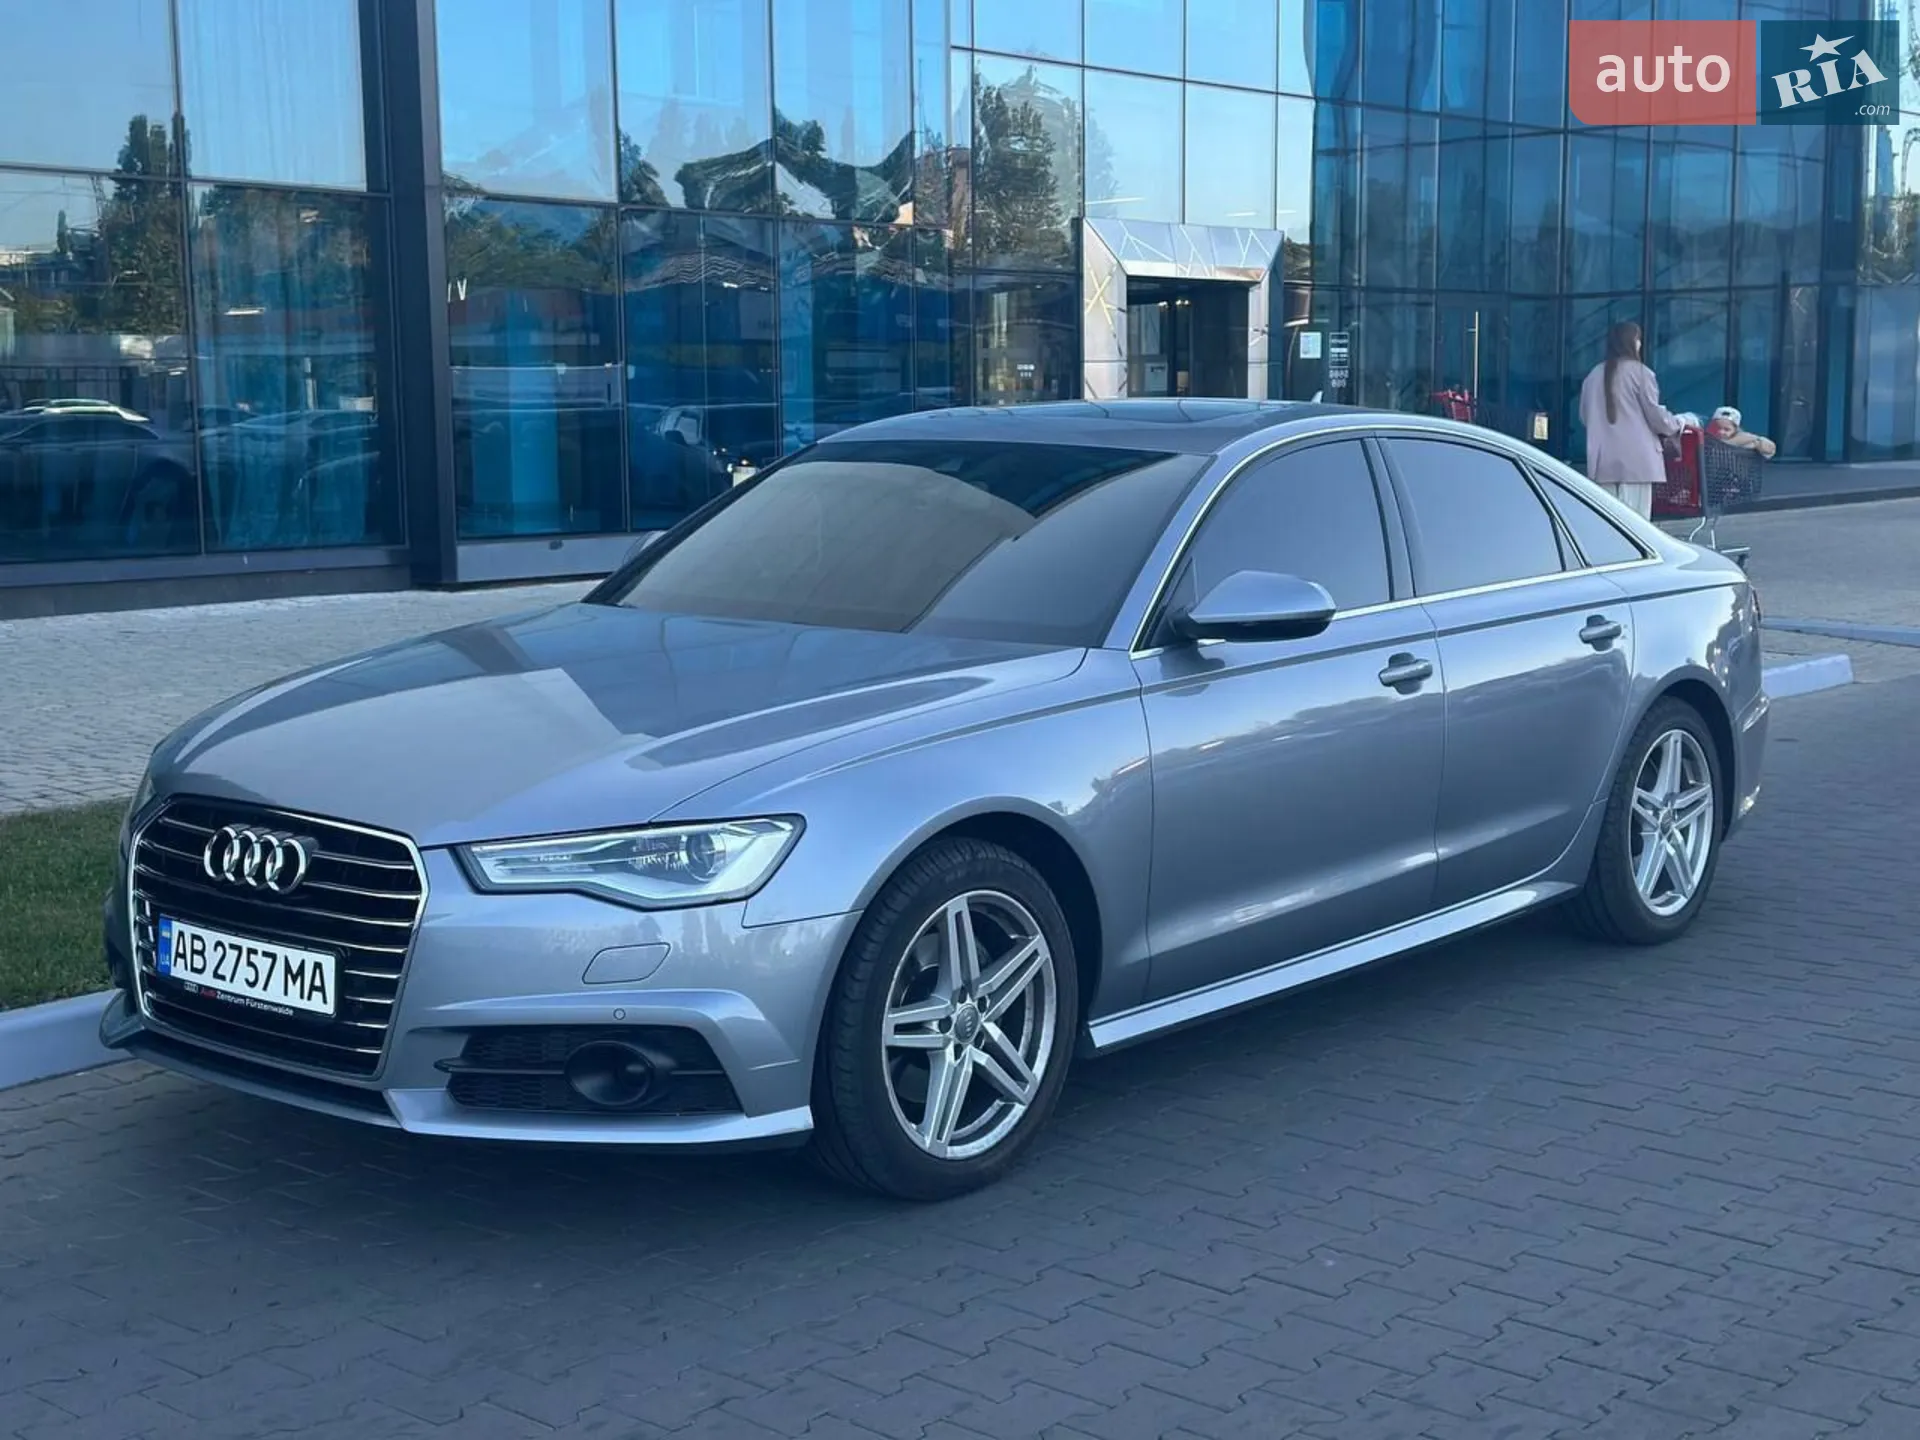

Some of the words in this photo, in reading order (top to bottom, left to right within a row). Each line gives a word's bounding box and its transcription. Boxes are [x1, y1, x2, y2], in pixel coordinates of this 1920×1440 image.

[173, 929, 207, 975] AB
[212, 940, 278, 991] 2757
[283, 955, 328, 1005] MA
[216, 990, 246, 1005] Zentrum
